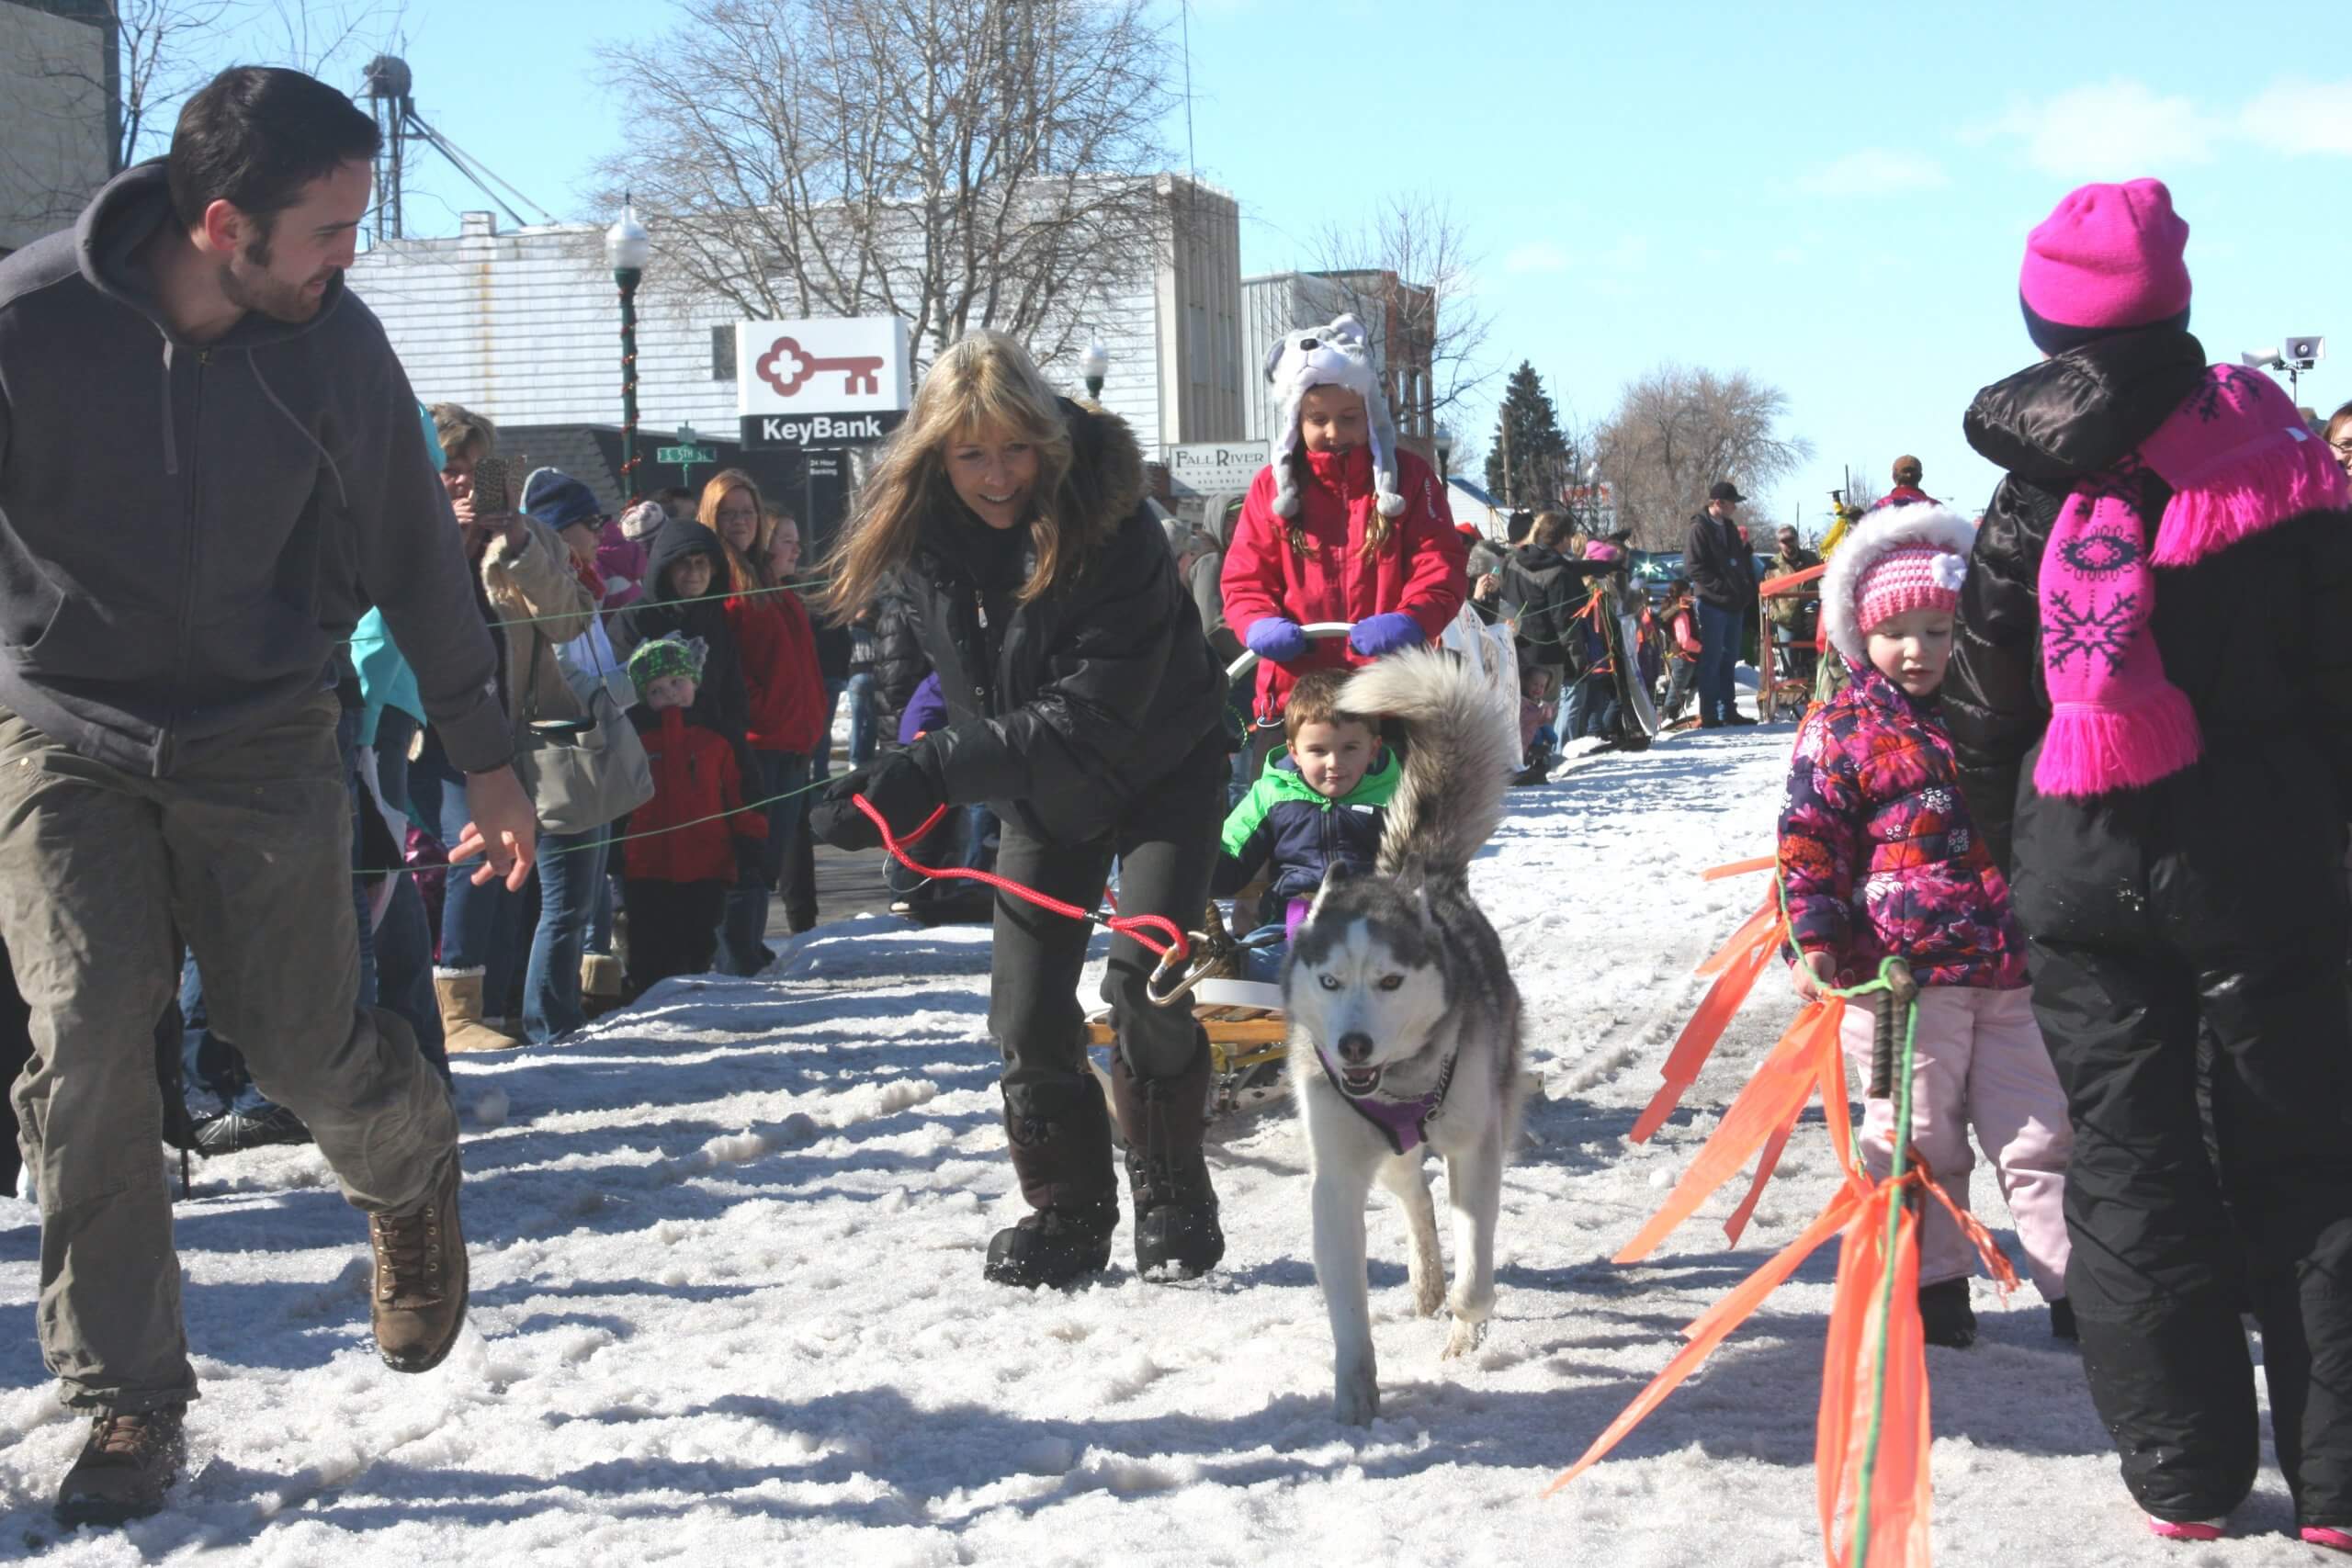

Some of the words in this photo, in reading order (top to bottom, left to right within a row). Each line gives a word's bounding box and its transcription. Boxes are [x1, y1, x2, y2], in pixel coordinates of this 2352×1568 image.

[763, 415, 883, 446] KeyBank
[1176, 451, 1213, 468] FALL
[1216, 449, 1263, 467] RIVER
[809, 468, 838, 477] Banking
